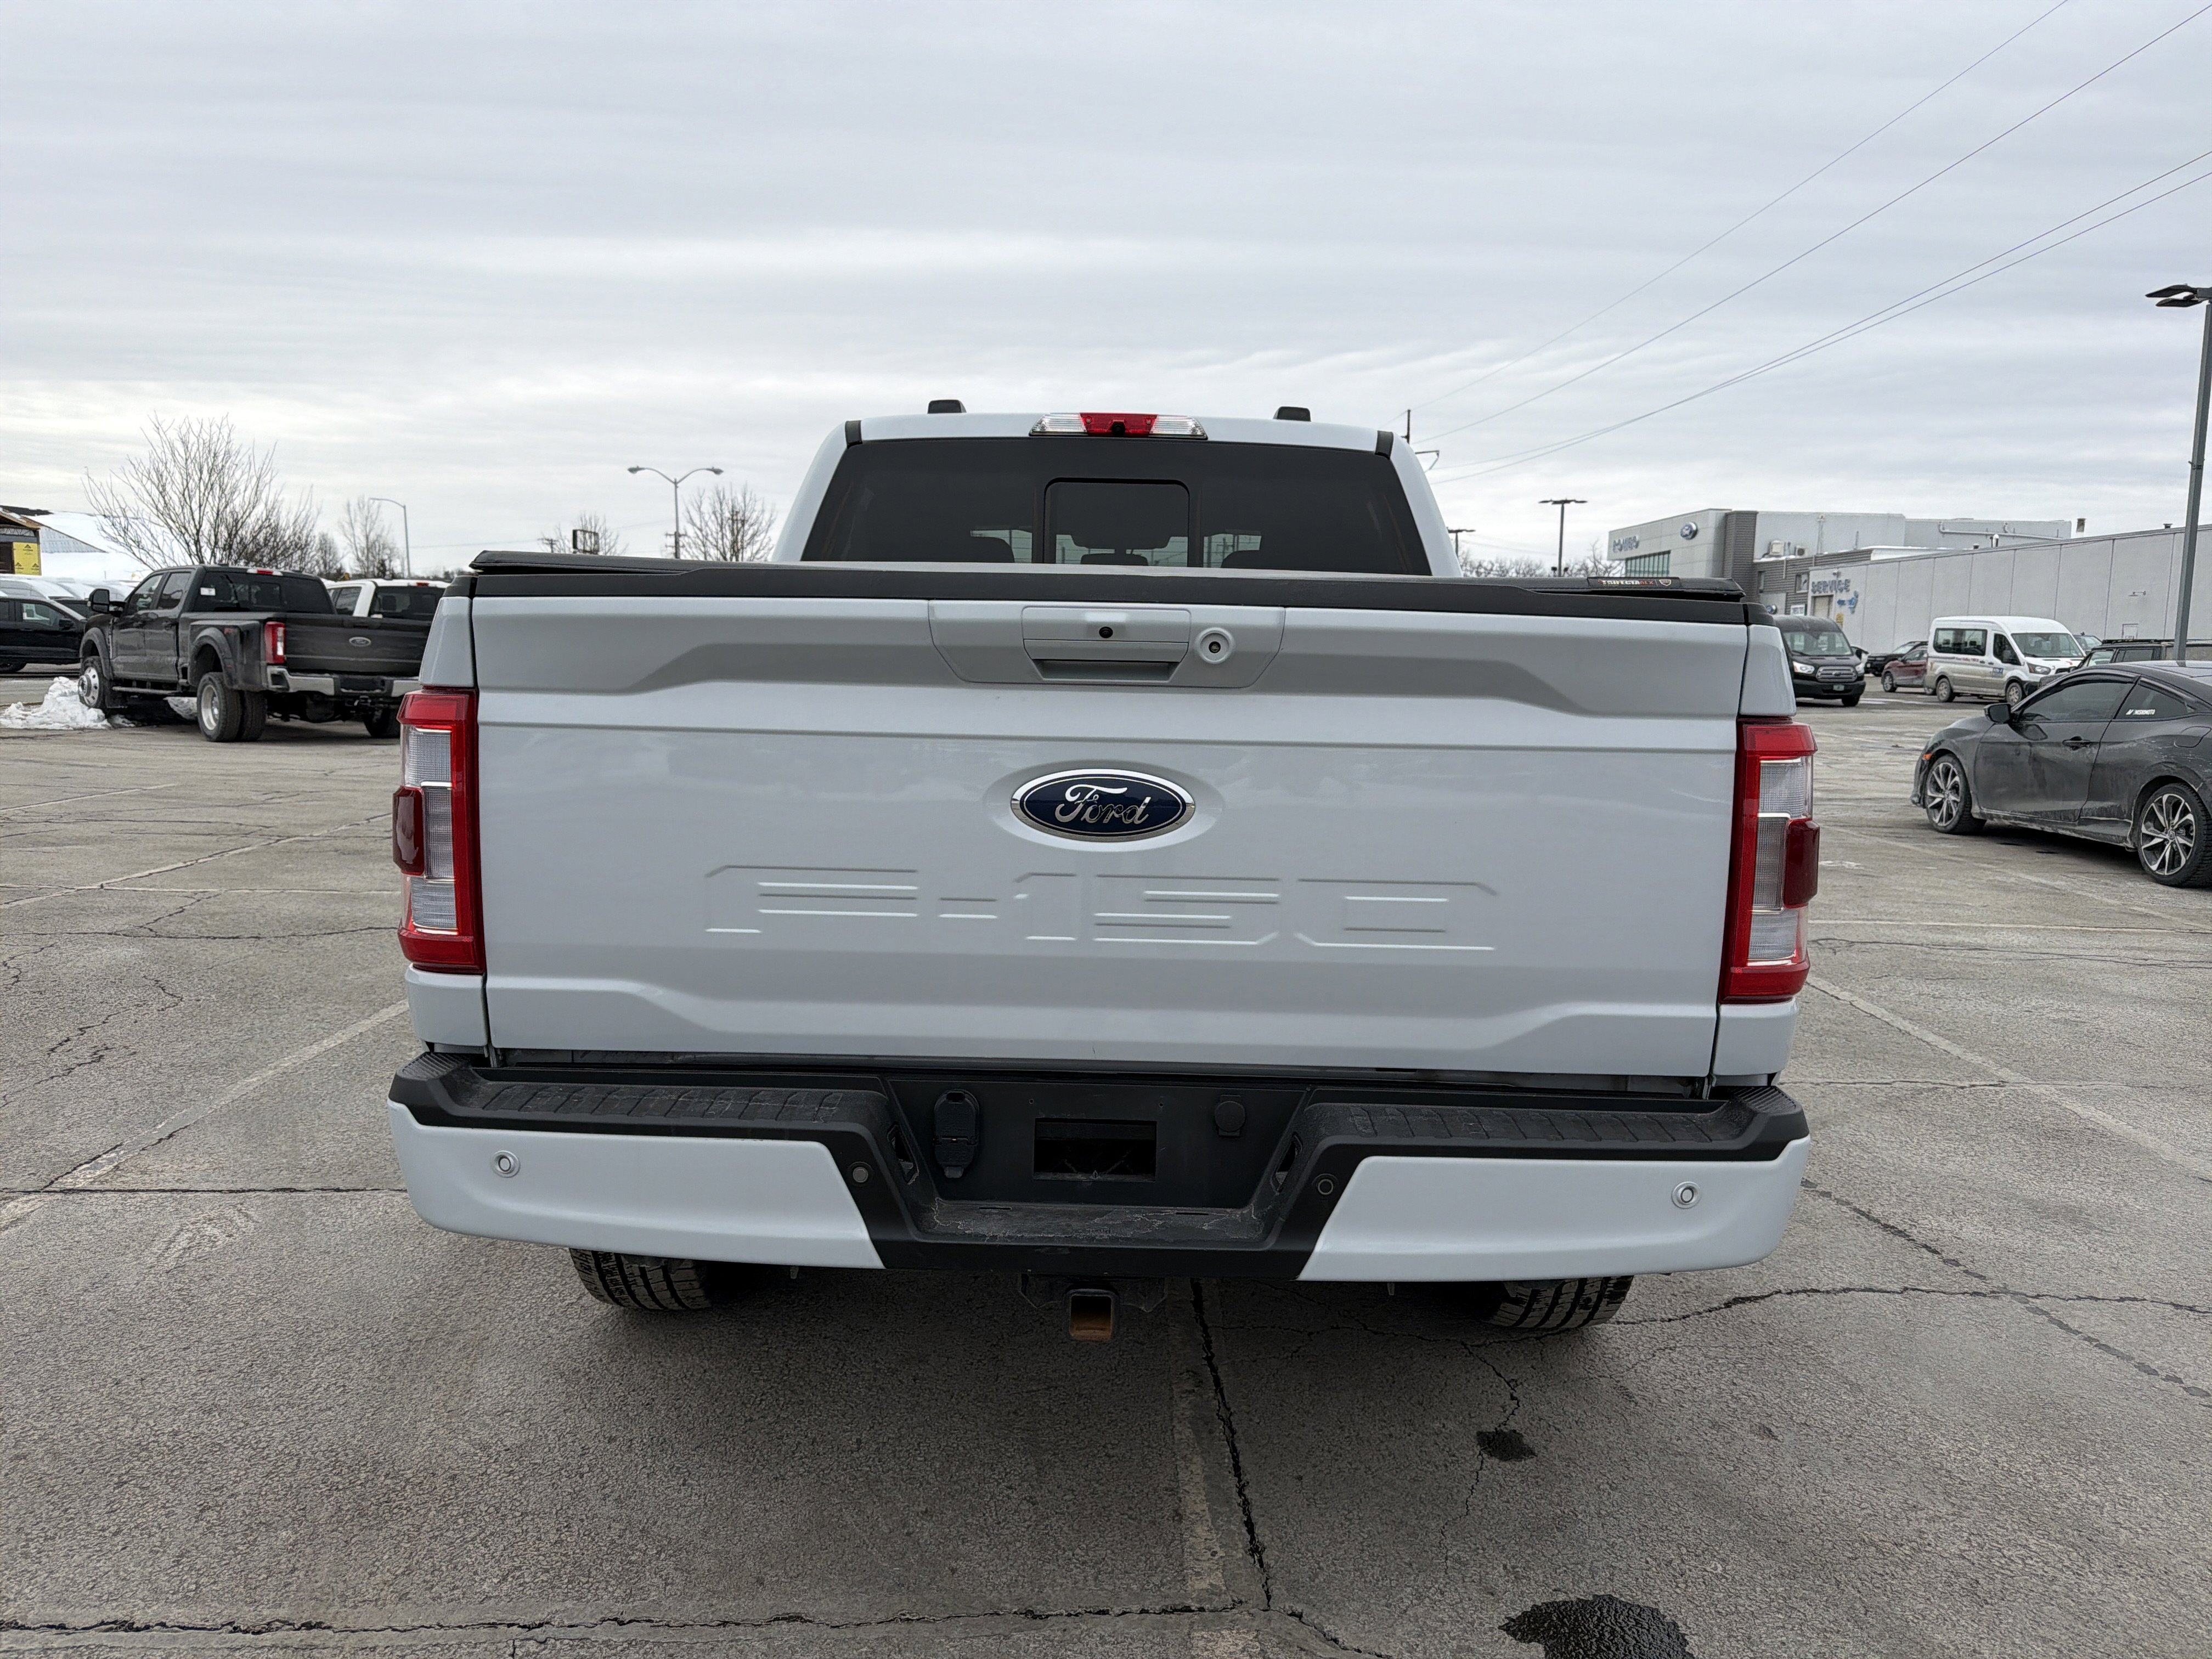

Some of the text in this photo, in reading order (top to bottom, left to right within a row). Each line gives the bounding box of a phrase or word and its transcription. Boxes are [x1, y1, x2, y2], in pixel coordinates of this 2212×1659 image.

[1812, 579, 1850, 594] SERVICE
[1054, 783, 1152, 825] Ford
[704, 864, 1497, 951] F-150
